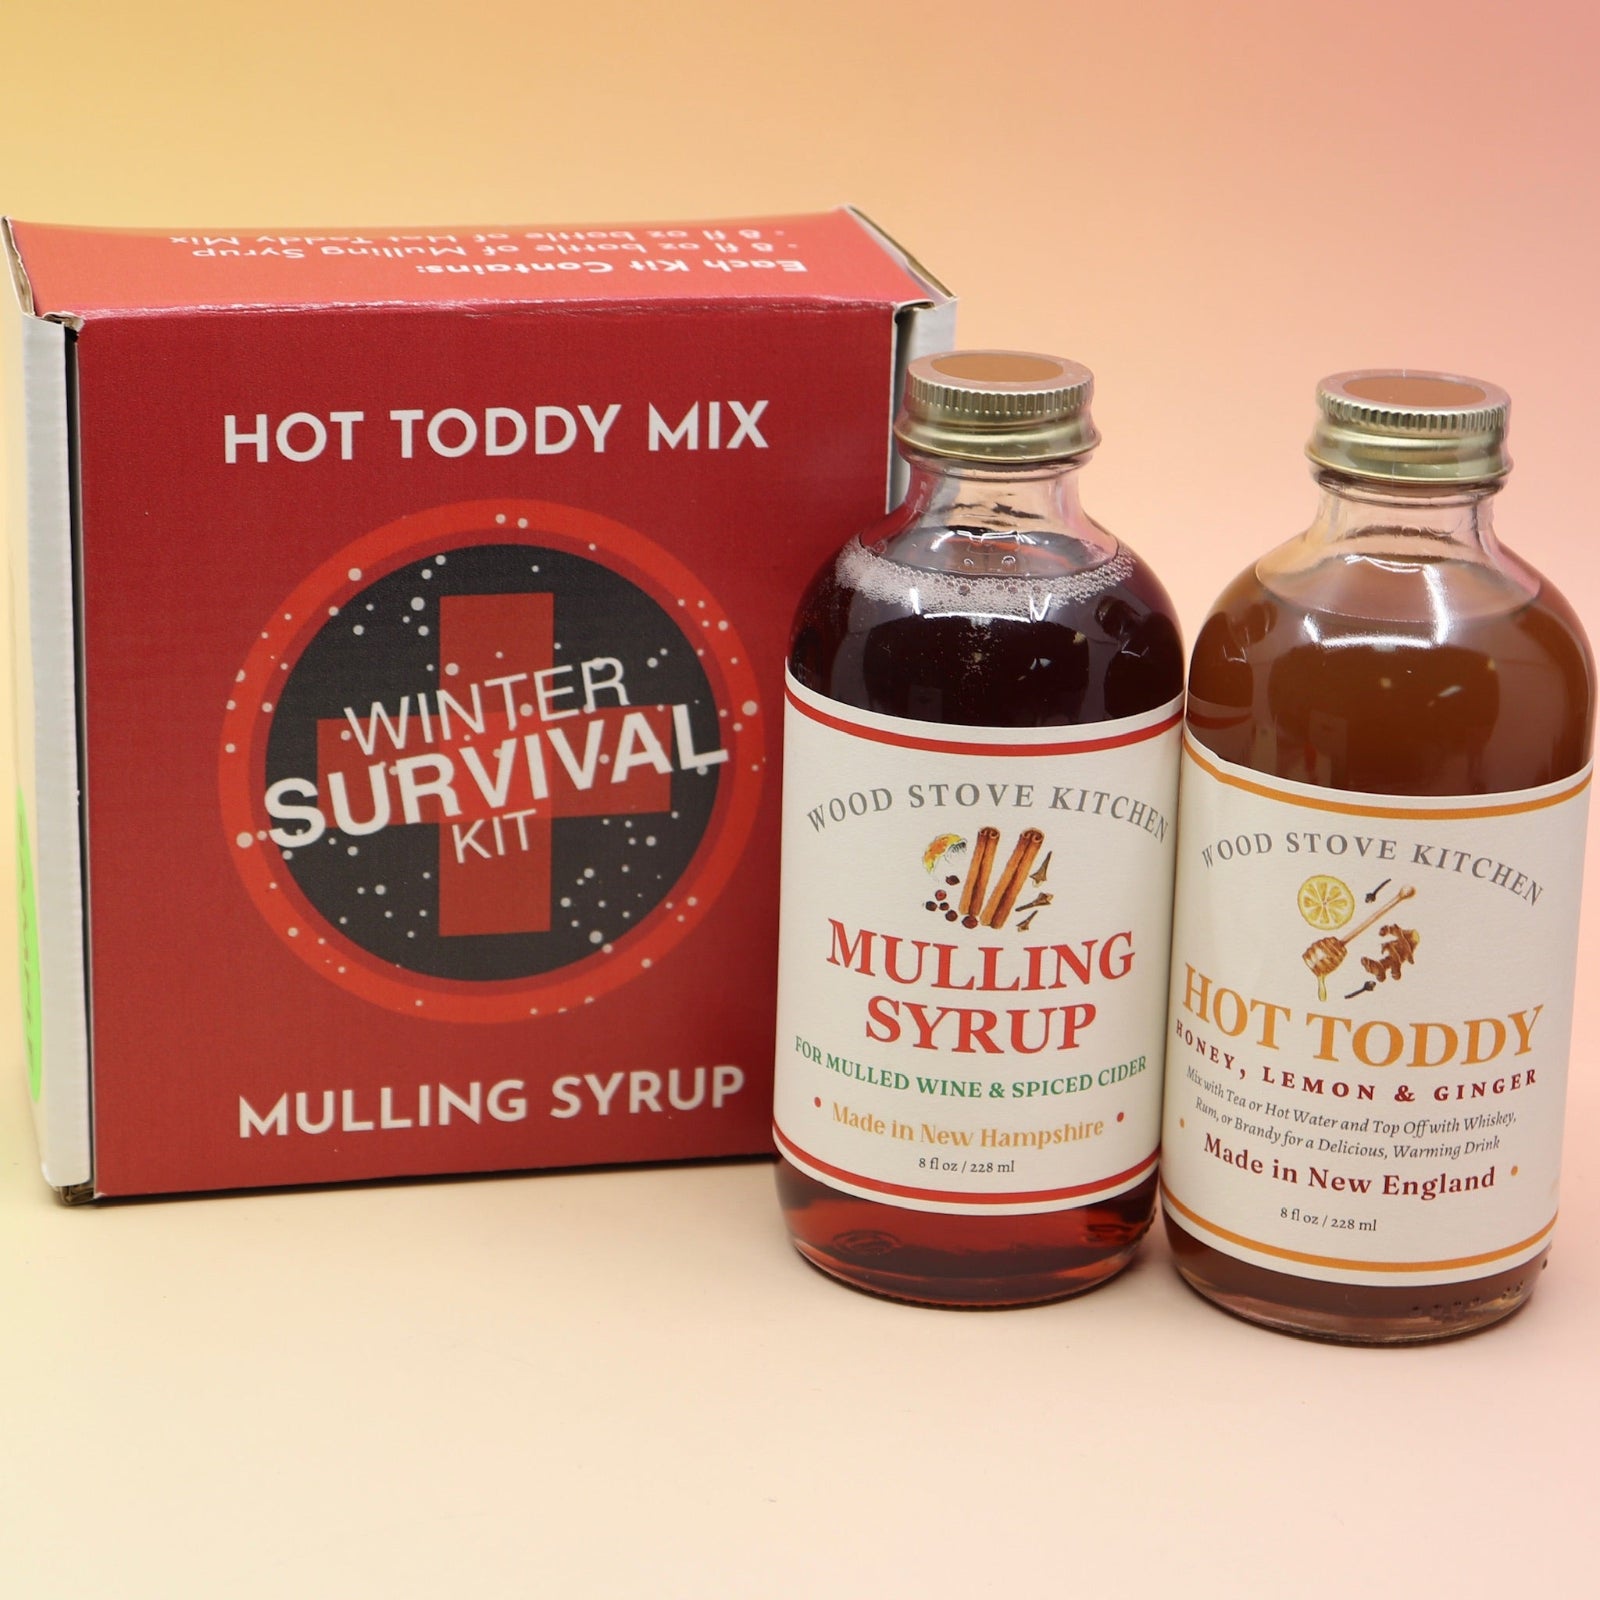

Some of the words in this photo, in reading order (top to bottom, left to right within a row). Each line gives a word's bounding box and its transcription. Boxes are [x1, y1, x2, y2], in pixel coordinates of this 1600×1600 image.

[169, 236, 240, 246] Mix
[472, 232, 510, 243] of
[524, 230, 636, 242] bottle
[646, 230, 688, 239] oz
[702, 229, 727, 241] fl
[737, 229, 762, 239] 8
[191, 246, 306, 259] Syrup
[320, 245, 467, 259] Mulling
[482, 244, 520, 256] of
[535, 242, 648, 255] bottle
[657, 242, 700, 251] oz
[714, 242, 740, 254] fl
[751, 242, 774, 252] 8
[415, 260, 614, 275] Contains:
[629, 258, 691, 273] Kit
[703, 258, 808, 273] Each
[224, 411, 364, 464] HOT
[390, 404, 622, 459] TODDY
[648, 400, 769, 451] MIX
[343, 656, 630, 756] WINTER
[264, 703, 729, 848] SURVIVAL
[806, 786, 893, 833] WOOD
[908, 783, 1034, 808] STOVE
[1048, 786, 1169, 843] KITCHEN
[452, 808, 536, 864] KIT
[1201, 832, 1273, 869] WOOD
[1285, 832, 1397, 860] STOVE
[1410, 844, 1543, 906] KITCHEN
[826, 918, 1135, 991] MULLING
[866, 995, 1097, 1054] SYRUP
[1183, 962, 1291, 1050] HOT
[1306, 1004, 1544, 1067] TODDY
[795, 1035, 822, 1065] FOR
[826, 1053, 910, 1090] MULLED
[916, 1077, 982, 1098] WINE
[988, 1082, 1005, 1098] &
[1012, 1074, 1093, 1098] SPICED
[1098, 1055, 1147, 1087] CIDER
[1176, 1019, 1247, 1080] HONEY,
[1262, 1066, 1375, 1100] LEMON
[1394, 1085, 1416, 1102] &
[1433, 1069, 1536, 1101] GINGER
[238, 1078, 526, 1138] MULLING
[549, 1065, 745, 1120] SYRUP
[1186, 1065, 1203, 1087] Mix
[1203, 1080, 1224, 1099] with
[1226, 1089, 1247, 1108] Tea
[1248, 1099, 1264, 1112] or
[1265, 1102, 1291, 1120] Hot
[1293, 1108, 1338, 1129] Water
[1340, 1117, 1370, 1133] and
[1373, 1119, 1400, 1138] Top
[1403, 1119, 1430, 1139] Off
[1429, 1117, 1460, 1134] with
[1463, 1110, 1517, 1131] Whiskey,
[833, 1102, 885, 1135] Made
[891, 1119, 914, 1141] in
[920, 1123, 975, 1147] New
[980, 1120, 1104, 1150] Hampshire
[1195, 1096, 1219, 1123] Rum,
[1221, 1111, 1233, 1126] or
[1234, 1117, 1281, 1145] Brandy
[1280, 1130, 1304, 1147] for
[1305, 1137, 1314, 1149] a
[1317, 1138, 1388, 1160] Delicious,
[1393, 1144, 1461, 1160] Warming
[1464, 1134, 1501, 1155] Drink
[918, 1157, 926, 1169] 8
[929, 1156, 939, 1170] fl
[942, 1162, 958, 1172] oz
[970, 1161, 993, 1173] 228
[997, 1160, 1015, 1173] ml
[1204, 1132, 1263, 1174] Made
[1272, 1159, 1297, 1184] in
[1308, 1166, 1372, 1194] New
[1382, 1166, 1496, 1200] England
[1279, 1207, 1288, 1219] 8
[1291, 1208, 1301, 1221] fl
[1303, 1213, 1319, 1225] oz
[1331, 1217, 1355, 1230] 228
[1358, 1218, 1377, 1231] ml
